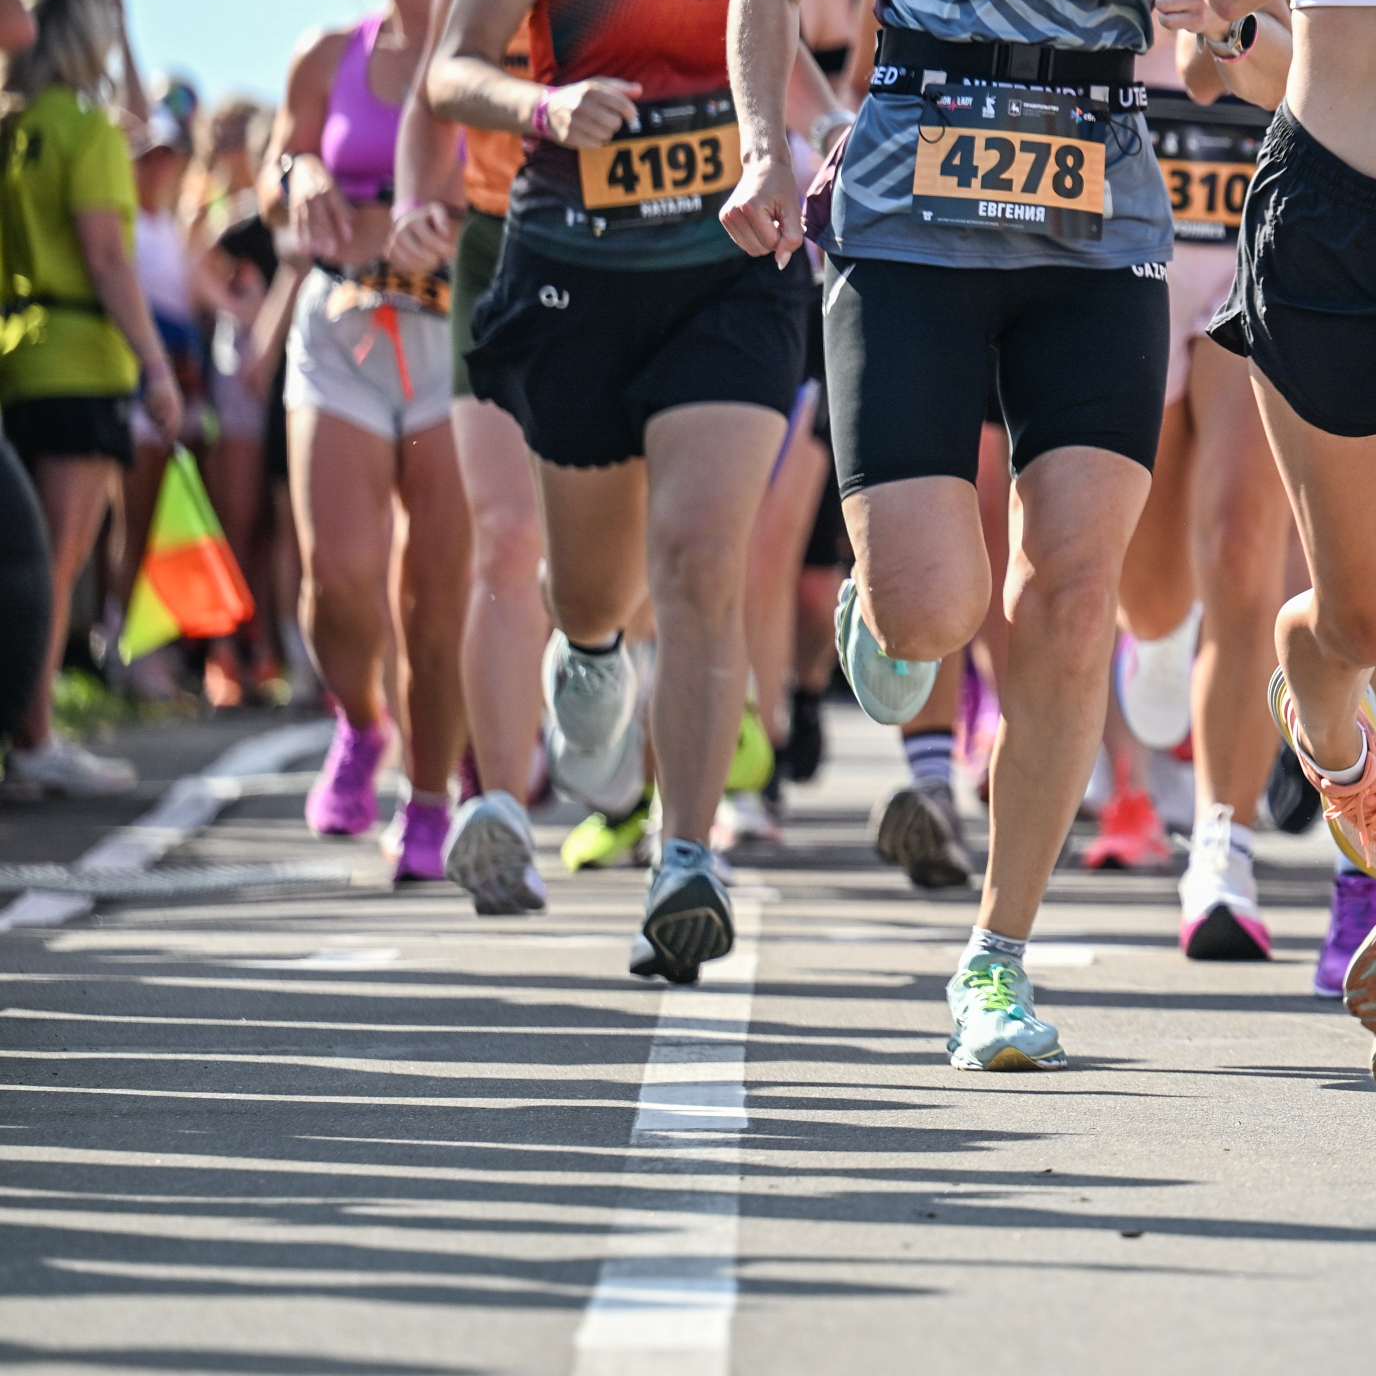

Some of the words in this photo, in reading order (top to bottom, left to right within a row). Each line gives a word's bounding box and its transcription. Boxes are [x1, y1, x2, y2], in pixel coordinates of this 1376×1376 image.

[606, 135, 725, 196] 4193
[938, 134, 1086, 200] 4278
[1169, 169, 1251, 215] 310
[978, 200, 1047, 223] ЕВГЕНИЯ
